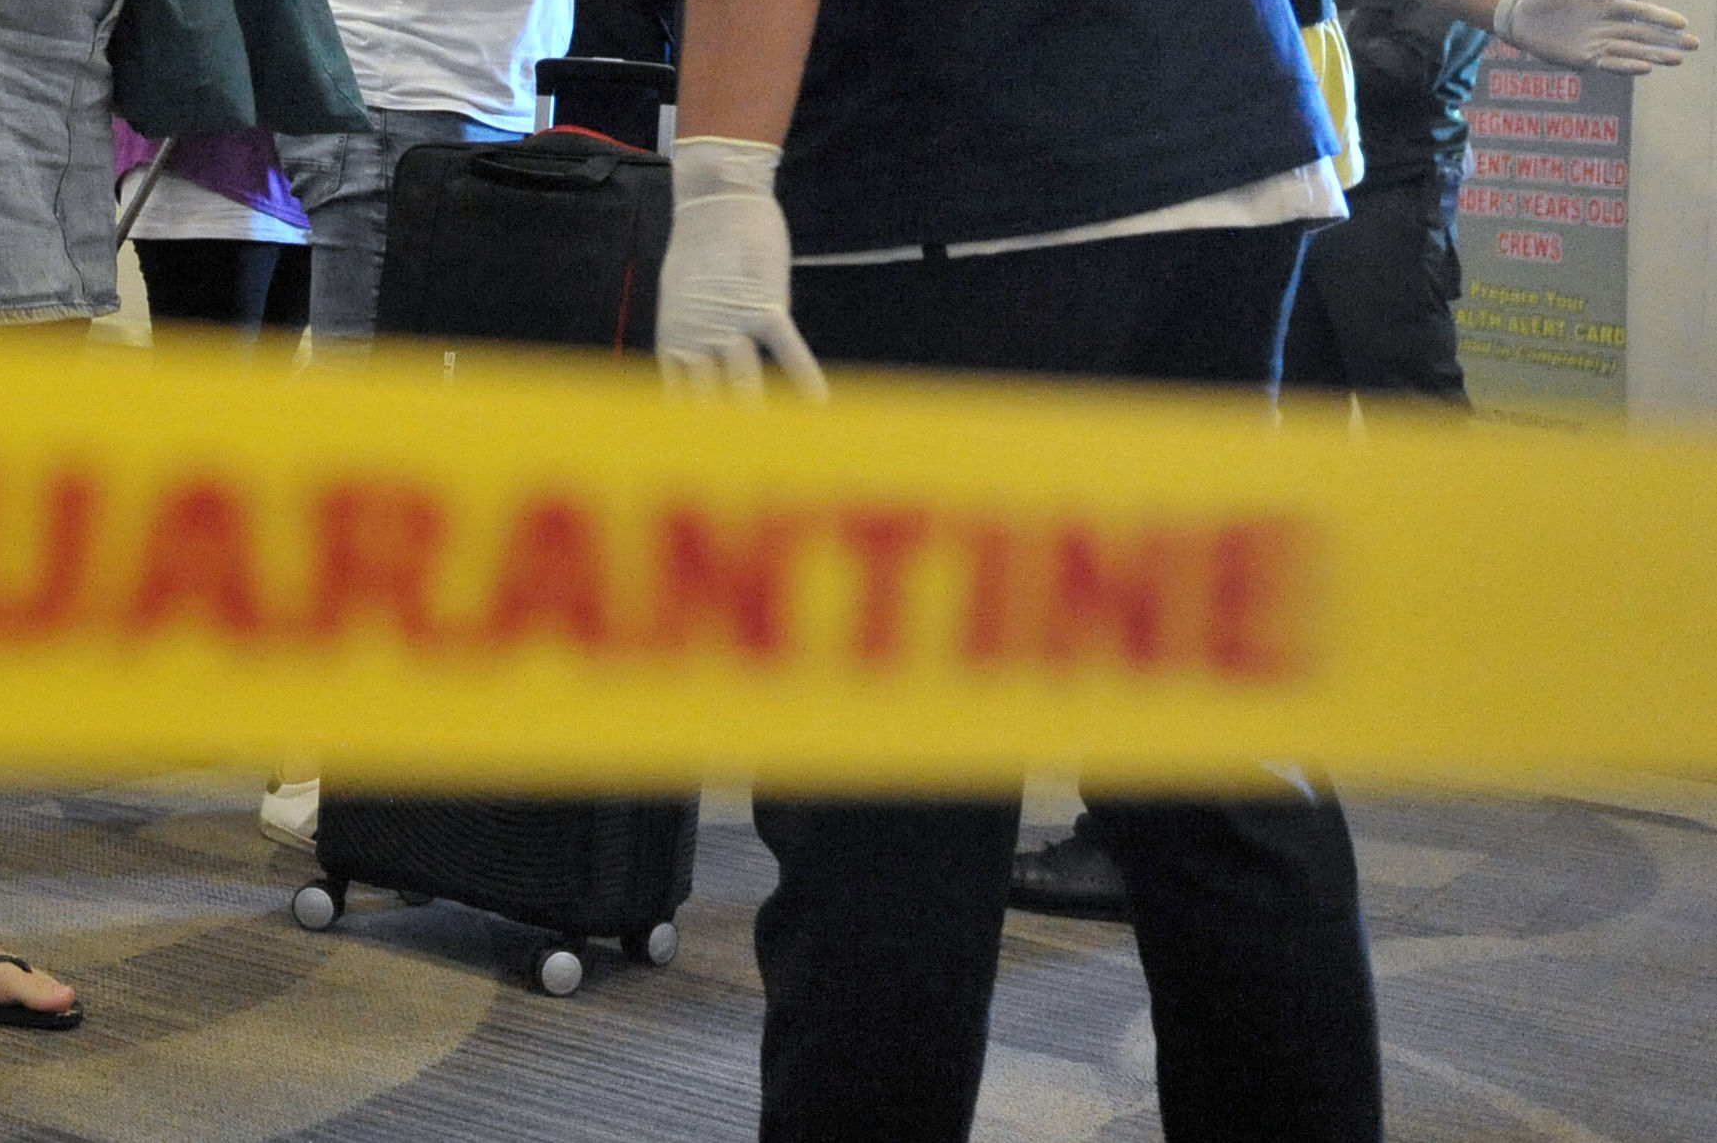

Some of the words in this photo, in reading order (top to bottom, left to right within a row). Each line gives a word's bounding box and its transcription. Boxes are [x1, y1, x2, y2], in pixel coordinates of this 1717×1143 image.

[1491, 72, 1580, 101] DISABLED
[1545, 115, 1618, 143] WOMAN
[1476, 151, 1511, 177] ENT
[1516, 155, 1565, 179] WITH
[1569, 157, 1626, 187] CHILD
[1522, 192, 1582, 221] YEARS
[1588, 197, 1626, 226] OLD
[1498, 230, 1561, 262] CREWS
